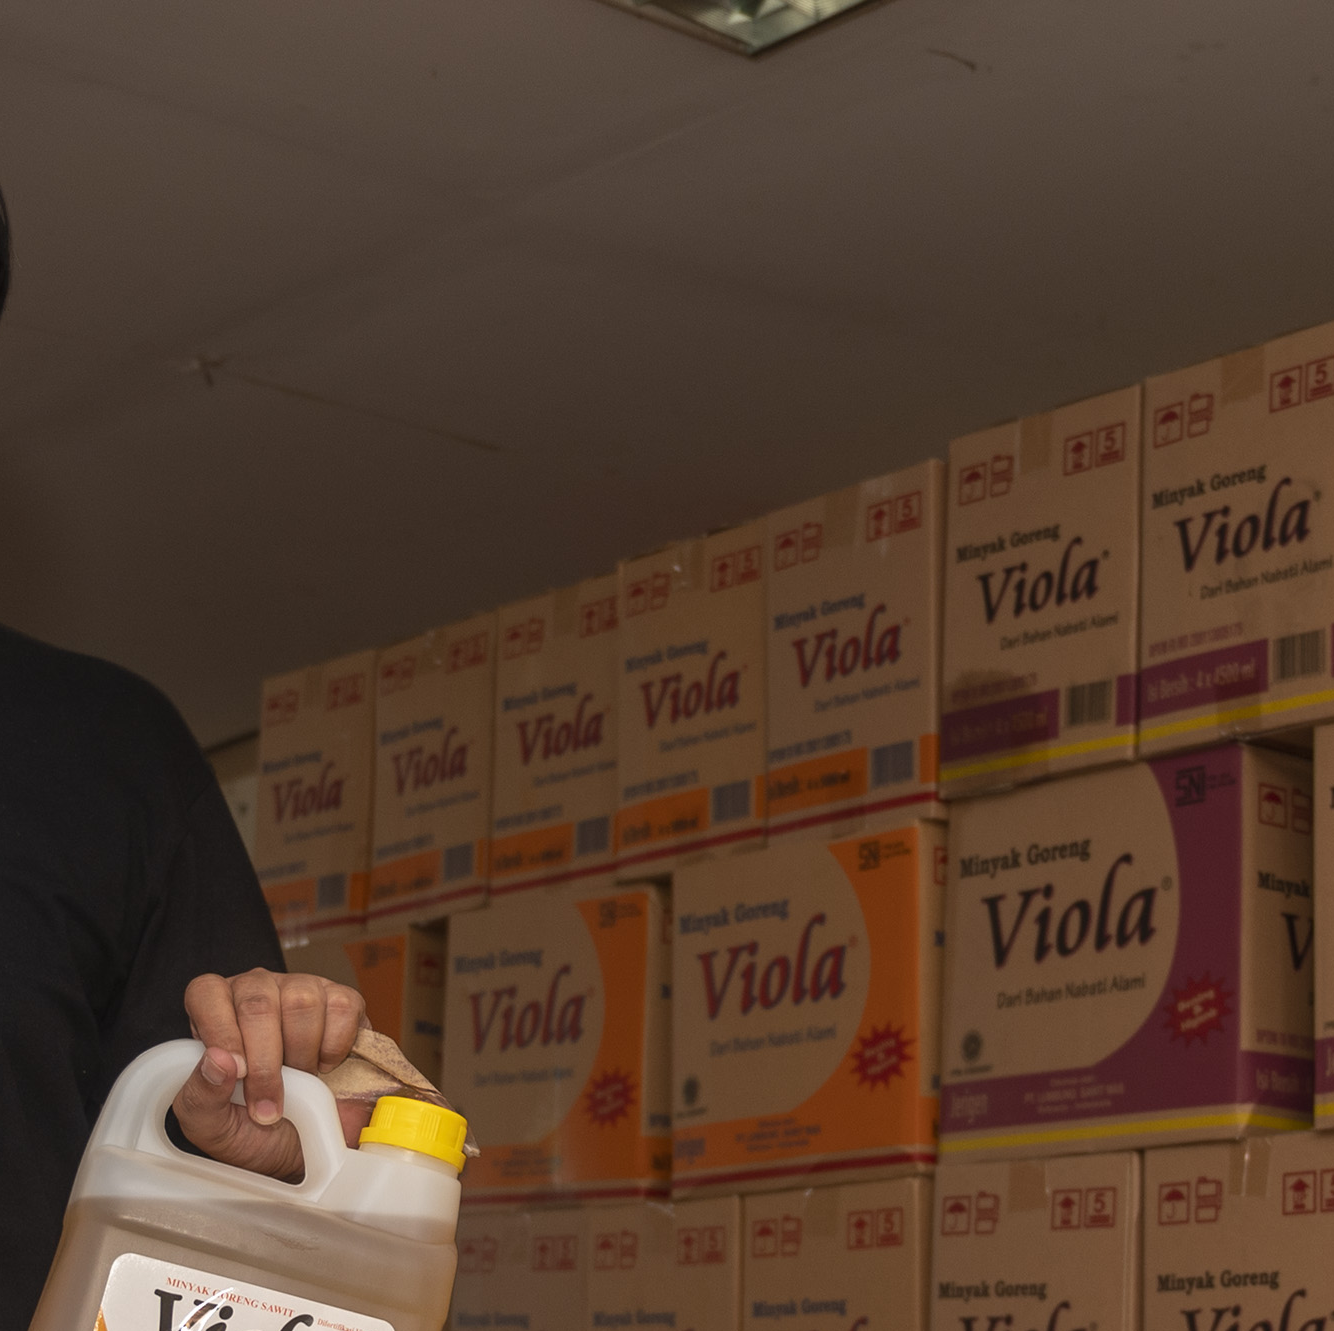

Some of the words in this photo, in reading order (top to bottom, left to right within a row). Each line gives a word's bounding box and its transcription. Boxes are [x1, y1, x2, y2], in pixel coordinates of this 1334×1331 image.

[1173, 476, 1314, 575] Viola
[975, 536, 1102, 627] Viola
[639, 650, 743, 730] Viola
[792, 605, 902, 690] Viola
[981, 852, 1159, 971] Viola
[468, 964, 587, 1056] Viola
[697, 912, 847, 1023] Viola
[166, 1277, 211, 1296] MINYAK
[261, 1300, 295, 1318] SAWIT
